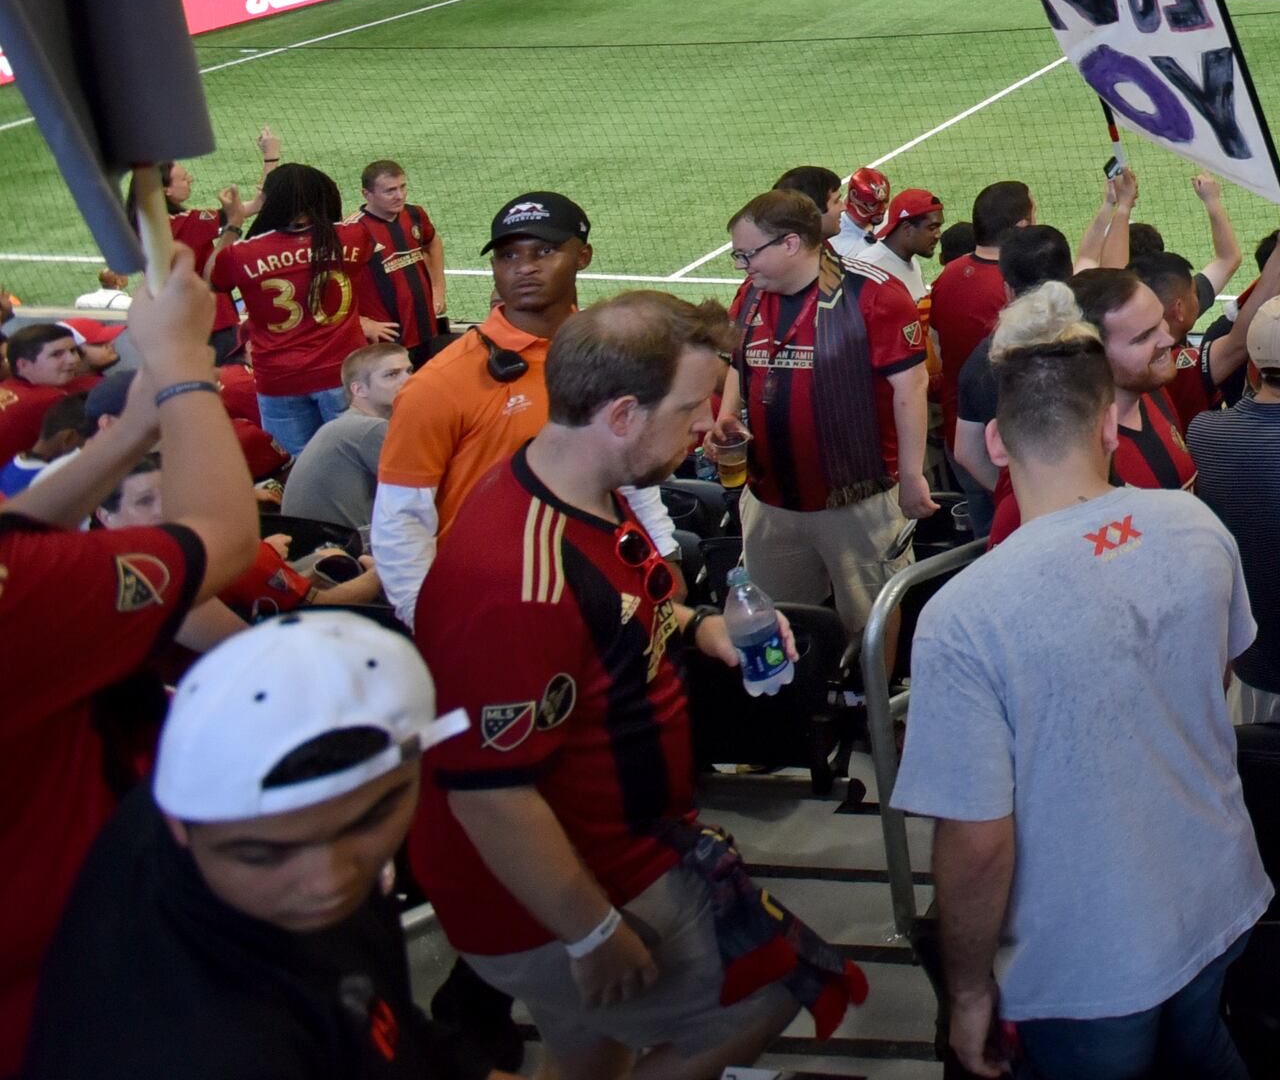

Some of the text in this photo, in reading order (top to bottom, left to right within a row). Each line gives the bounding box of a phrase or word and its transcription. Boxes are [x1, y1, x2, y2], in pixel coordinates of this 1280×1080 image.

[260, 269, 353, 334] 30
[746, 349, 814, 360] AMERIAN FAMI
[1083, 514, 1143, 557] XX
[486, 708, 515, 721] MLS
